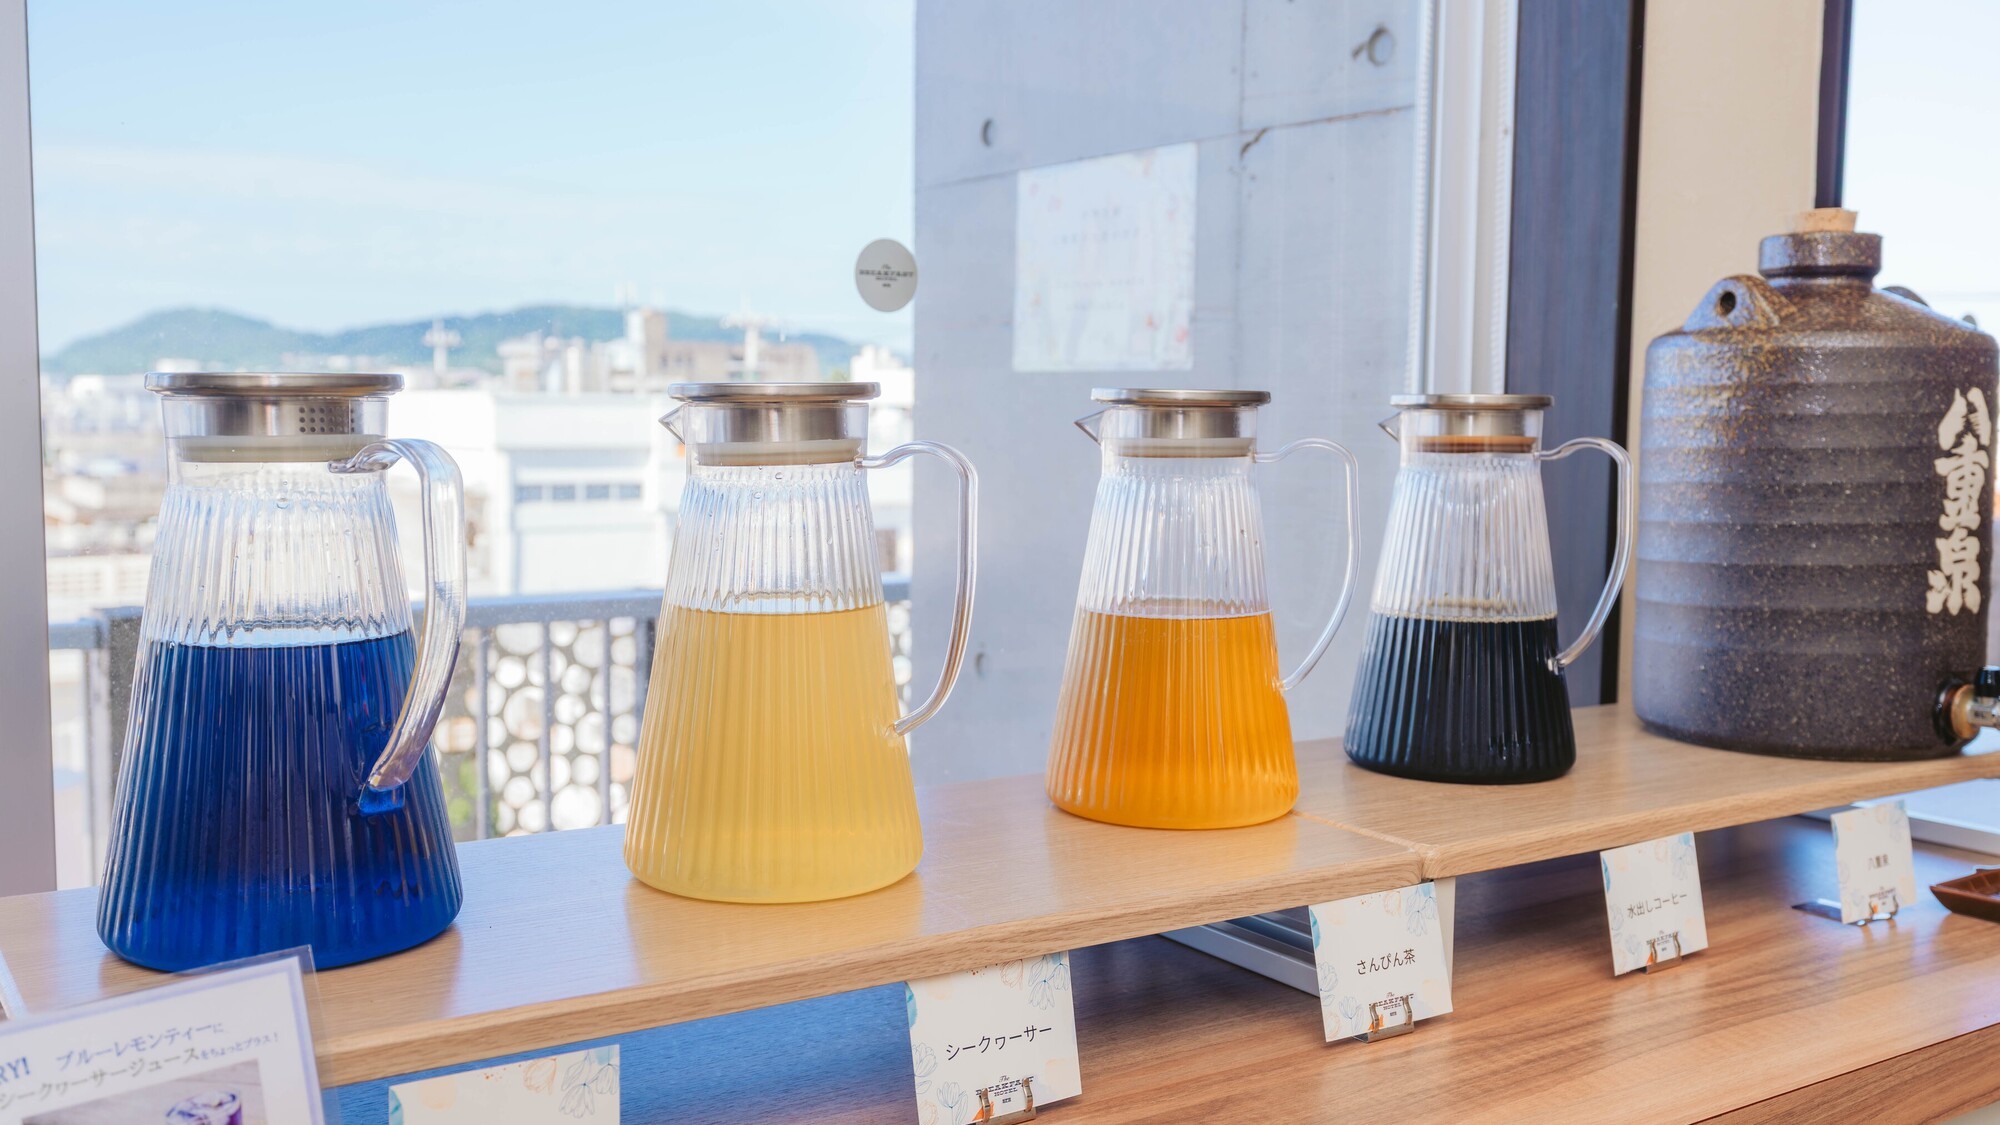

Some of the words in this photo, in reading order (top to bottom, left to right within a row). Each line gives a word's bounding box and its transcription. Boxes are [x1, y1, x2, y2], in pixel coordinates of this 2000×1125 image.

[1926, 387, 1991, 615] 八重泉
[1627, 893, 1687, 919] 水出しコーヒー
[1357, 948, 1416, 975] さんぴん茶
